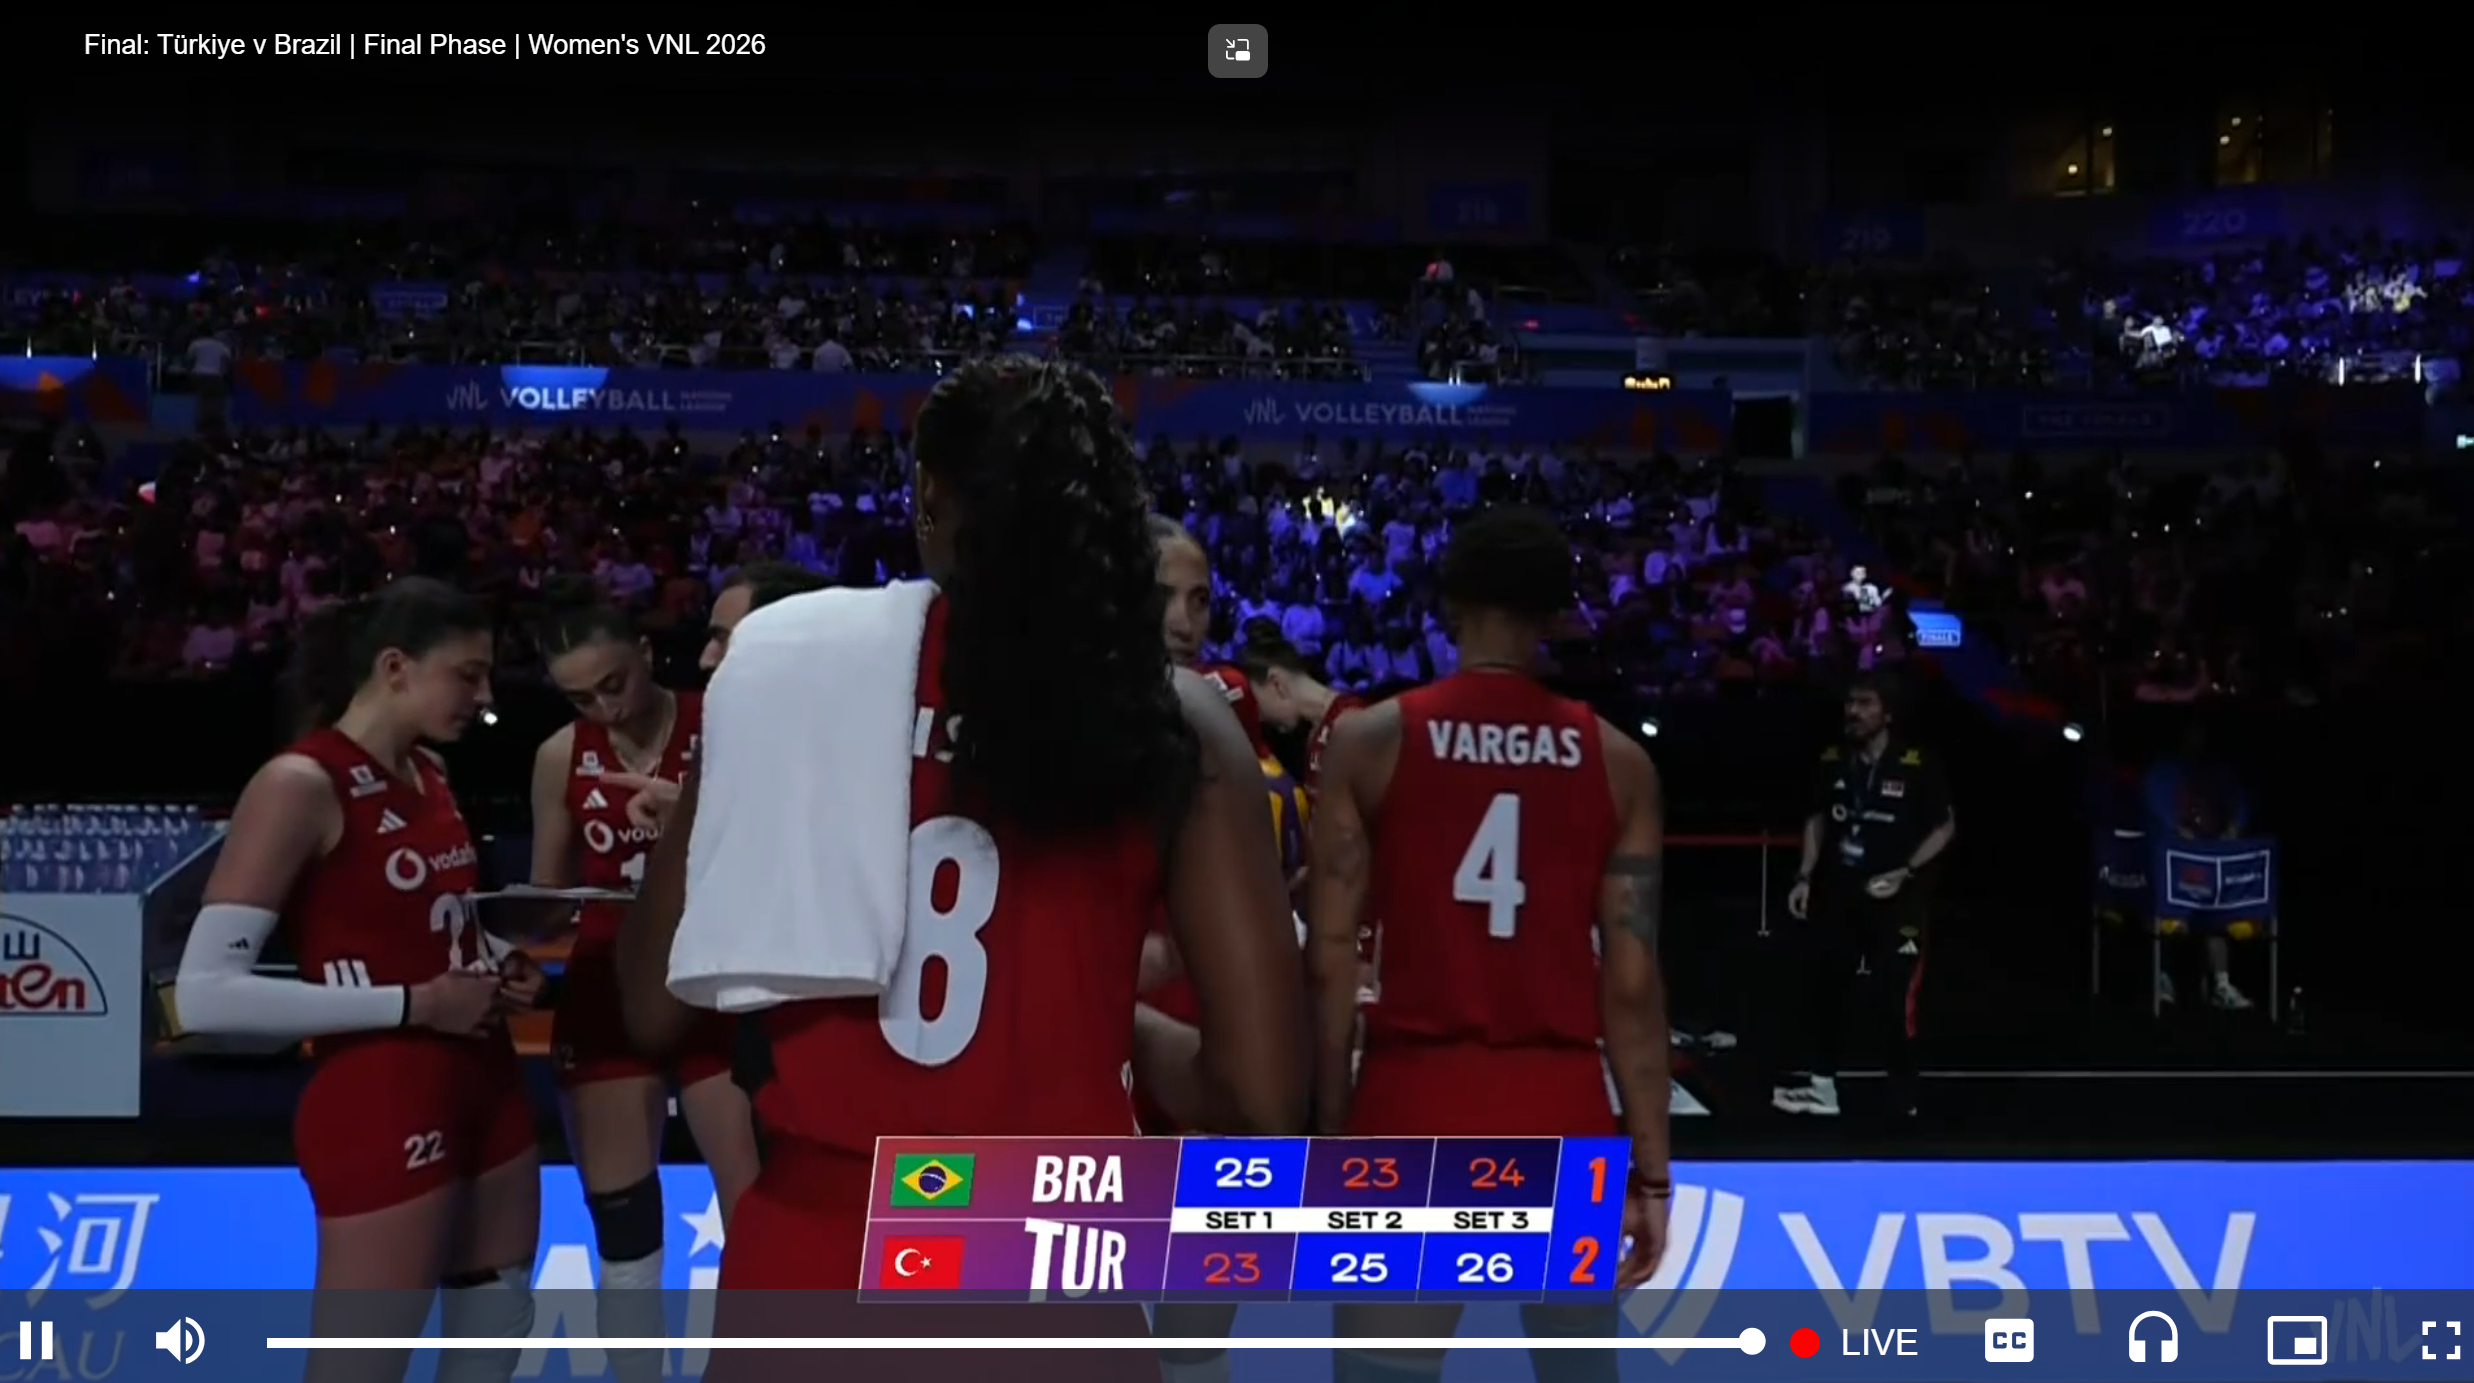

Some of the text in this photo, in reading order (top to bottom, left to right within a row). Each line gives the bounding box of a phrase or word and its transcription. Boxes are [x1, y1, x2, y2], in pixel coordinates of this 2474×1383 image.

[2182, 209, 2246, 236] 220
[501, 386, 675, 411] VOLLEYBALL
[1295, 401, 1463, 427] VOLLEYBALL
[1427, 719, 1582, 768] VARGAS
[1453, 792, 1526, 939] 4
[878, 814, 1000, 1068] 8
[404, 1129, 447, 1171] 22
[0, 1190, 160, 1311] 河
[1778, 1212, 2257, 1335] VBTV
